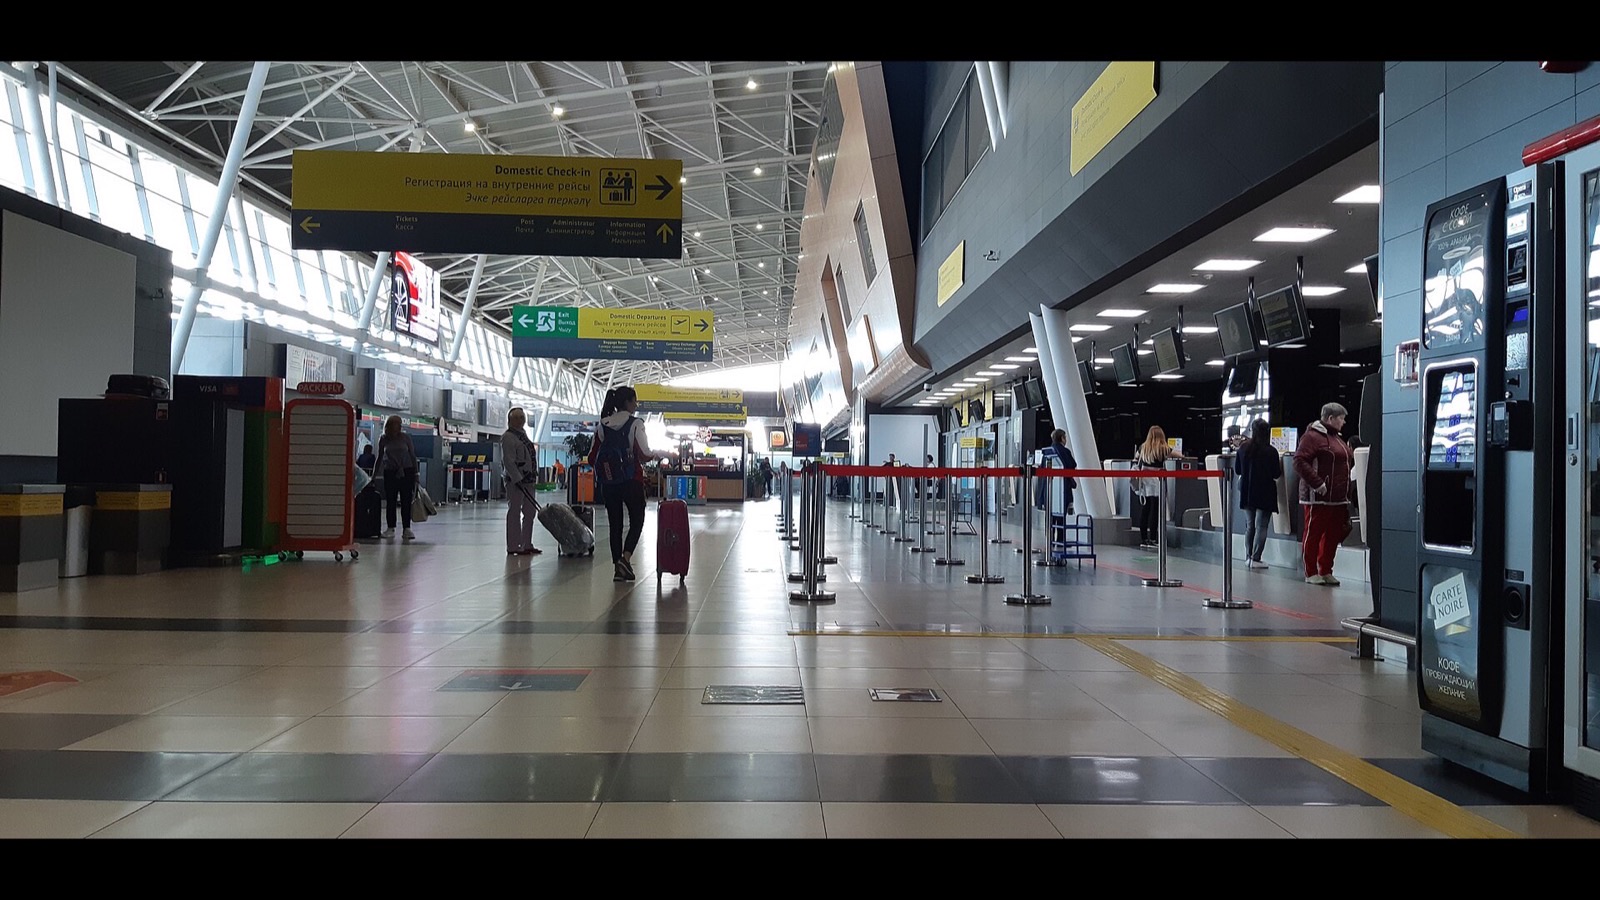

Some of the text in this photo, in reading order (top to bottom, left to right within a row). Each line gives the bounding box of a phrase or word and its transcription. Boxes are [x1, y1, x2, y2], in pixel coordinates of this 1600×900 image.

[495, 165, 591, 177] Domestic Check-in
[405, 176, 472, 189] Регистрация
[492, 181, 554, 192] внутренние
[558, 181, 591, 192] рейсы
[465, 193, 489, 203] Эчке
[491, 193, 544, 205] рейсларга
[1450, 203, 1470, 220] КОФЕ
[395, 215, 418, 223] Tickets
[520, 218, 534, 226] Post
[552, 219, 595, 228] Administrator
[395, 223, 414, 231] Касса
[515, 226, 534, 234] Почта
[610, 221, 646, 229] Information
[1442, 222, 1448, 233] С
[545, 227, 595, 236] Администратор
[637, 314, 666, 322] Departures
[199, 385, 217, 393] VISA
[298, 384, 342, 393] PACK&FLY
[1435, 583, 1462, 605] CARTE
[1438, 597, 1465, 619] NOIRE
[1437, 656, 1460, 674] КОФЕ
[1425, 667, 1476, 690] ПРОБУЖДАЮЩИЙ
[1438, 684, 1467, 701] ЖЕЛАНИЕ
